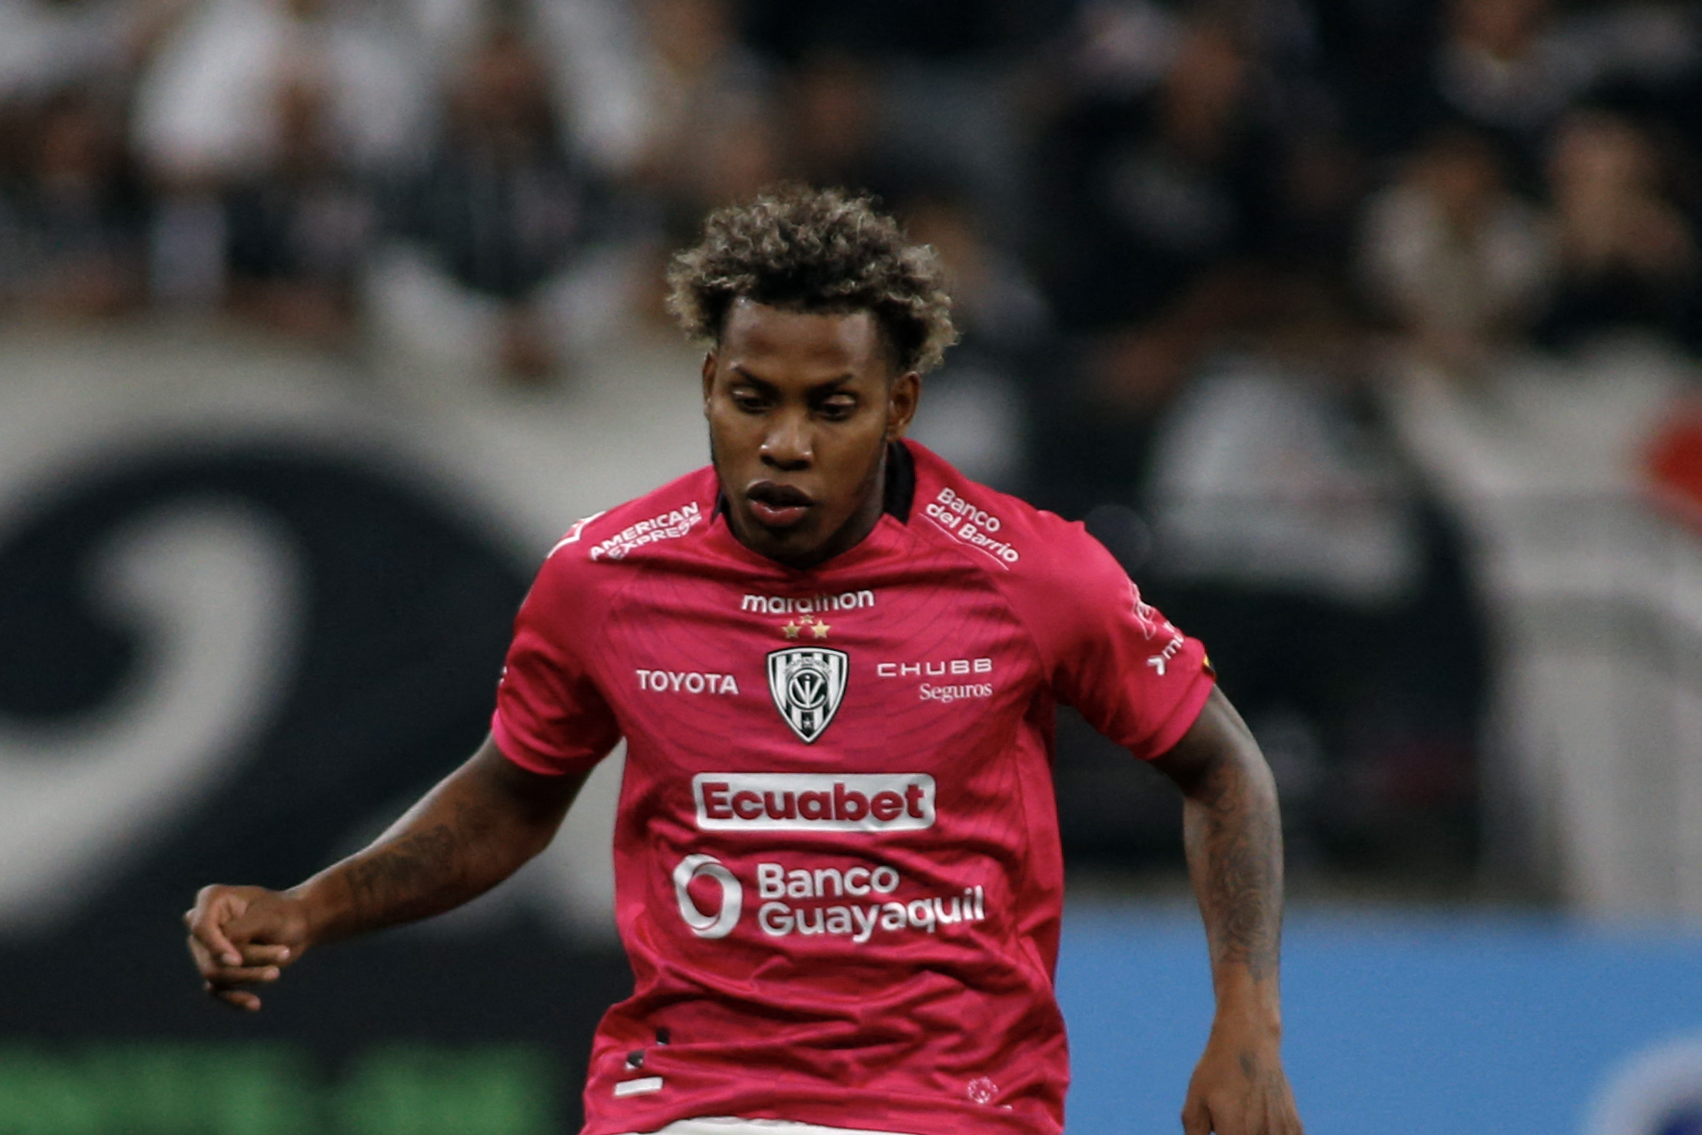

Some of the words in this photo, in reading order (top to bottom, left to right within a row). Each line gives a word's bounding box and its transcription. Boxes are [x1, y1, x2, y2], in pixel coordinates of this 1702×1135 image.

[937, 487, 1001, 533] Banco
[590, 501, 699, 561] AMERICAN
[607, 513, 702, 560] EXPRESS
[926, 503, 962, 528] del
[958, 523, 1019, 562] Barrio
[741, 588, 875, 614] marathon
[636, 669, 739, 695] TOYOTA
[877, 658, 993, 678] CHUBB
[919, 682, 993, 703] Seguros
[701, 782, 925, 822] Ecuabet
[757, 862, 900, 899] Banco
[758, 885, 986, 944] Guayaquil
